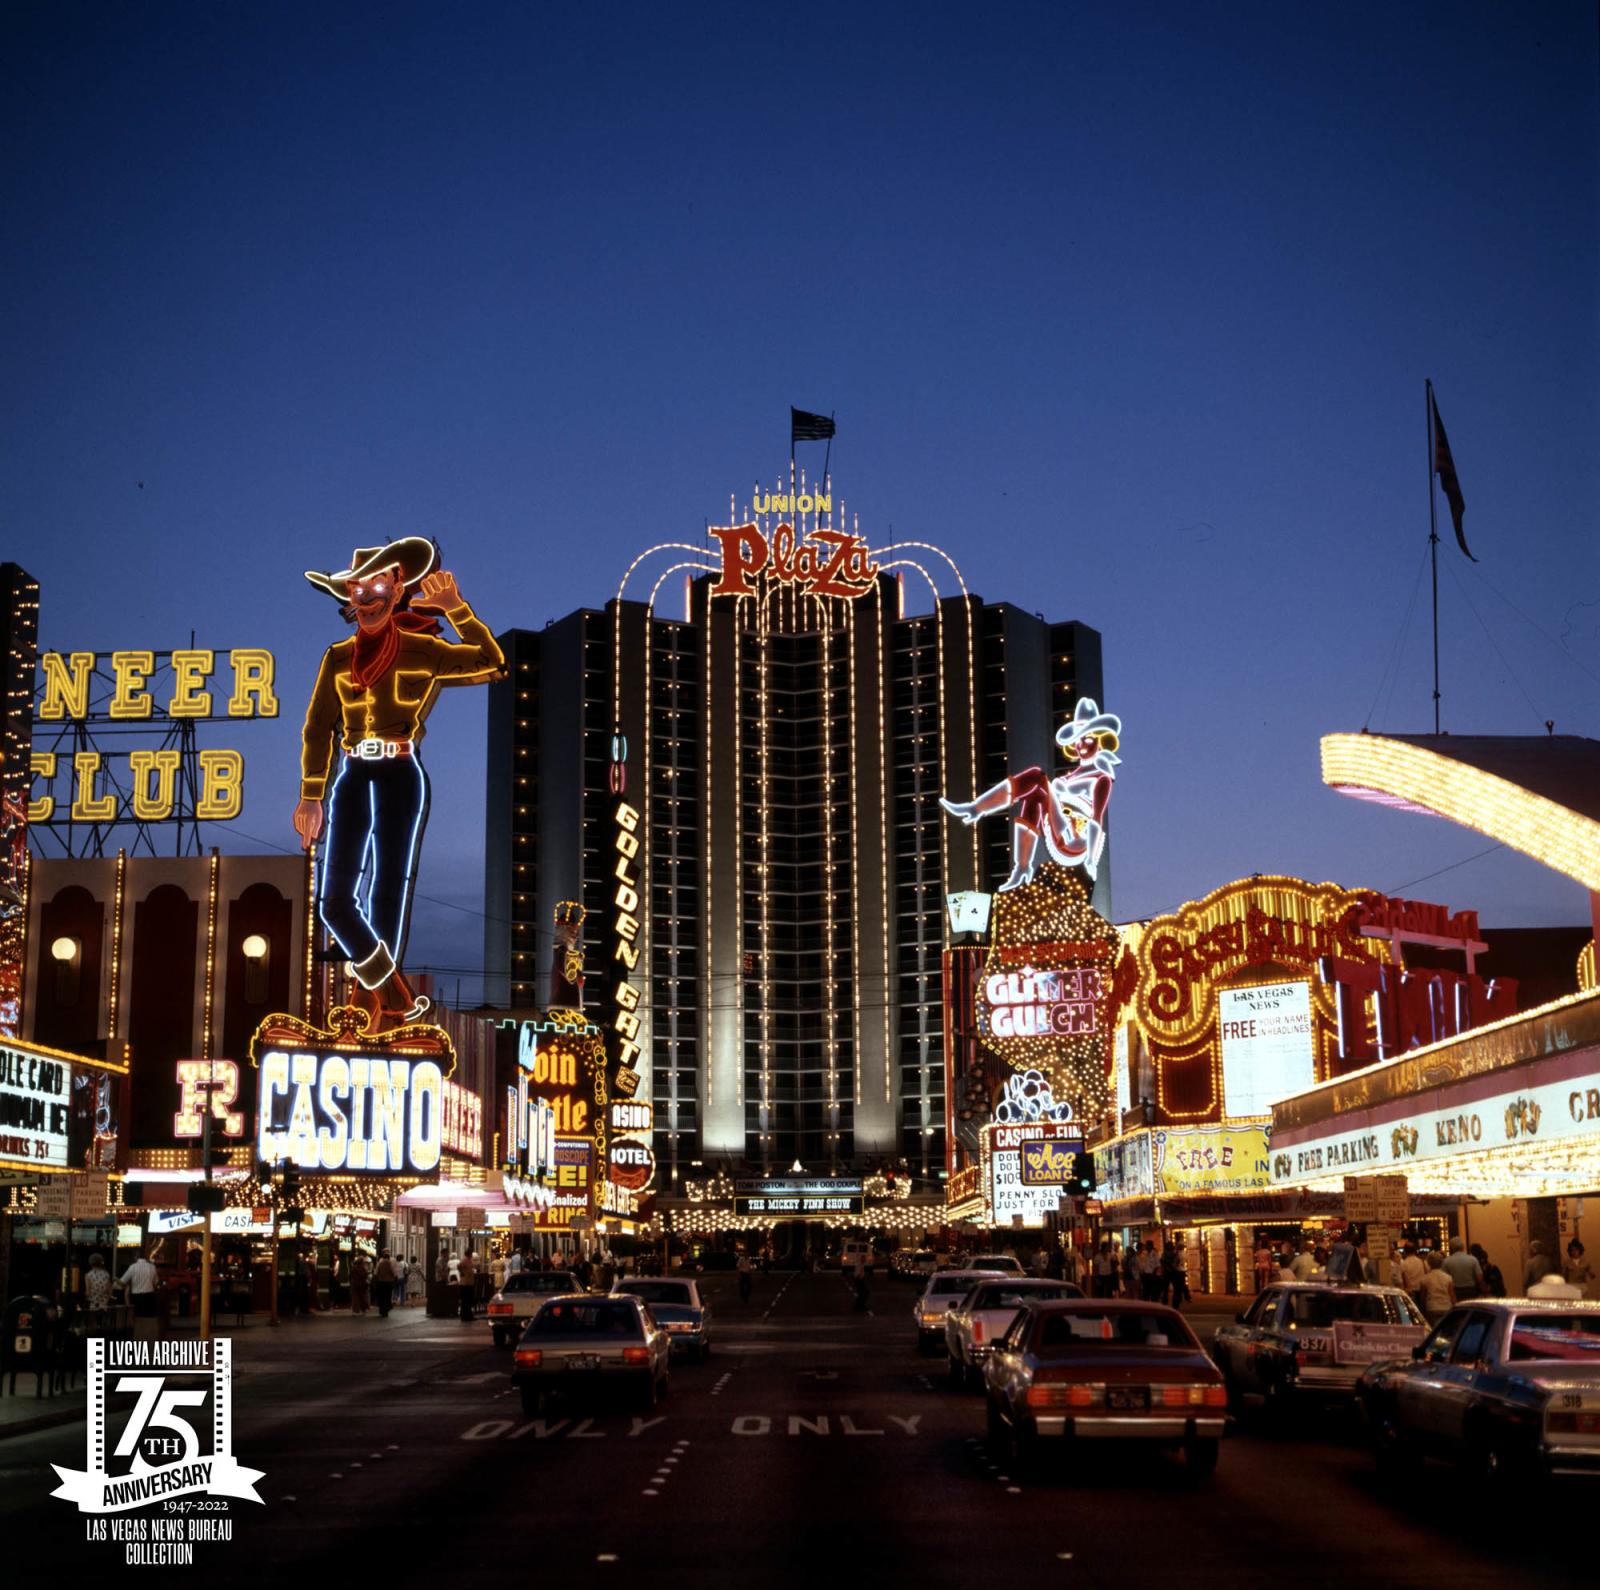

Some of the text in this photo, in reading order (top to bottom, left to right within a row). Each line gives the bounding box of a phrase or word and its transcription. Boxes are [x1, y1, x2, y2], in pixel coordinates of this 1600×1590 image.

[753, 495, 831, 513] UNION
[708, 521, 879, 598] Plaza
[40, 649, 278, 719] NEER
[27, 750, 244, 821] CLUB
[615, 802, 640, 972] GOLDEN
[1233, 986, 1294, 1002] LAS VEGAS
[1249, 1000, 1280, 1011] NEWS
[990, 1003, 1097, 1037] GULCH
[1222, 1019, 1257, 1041] FREE
[1284, 1013, 1308, 1024] NAME
[1267, 1024, 1310, 1036] HEADLINES
[615, 982, 641, 1097] GATE
[527, 1044, 577, 1085] oin
[258, 1052, 442, 1171] CASINO
[996, 1127, 1044, 1147] CASINO
[1435, 1114, 1481, 1147] KENO
[1176, 1146, 1234, 1171] FREE
[1298, 1135, 1379, 1173] FREE PARKING
[1029, 1169, 1060, 1181] LOAN
[1255, 1160, 1270, 1172] IN
[1203, 1178, 1241, 1189] FAMOUS
[1244, 1177, 1264, 1187] LAS
[748, 1199, 851, 1210] THE MICKEY FINN SHOW
[996, 1199, 1054, 1210] JUST FOR
[1000, 1190, 1036, 1200] PENNY
[168, 1213, 197, 1229] VISA
[225, 1215, 254, 1227] CASH
[460, 1416, 666, 1440] ONLY
[731, 1414, 924, 1437] ONLY
